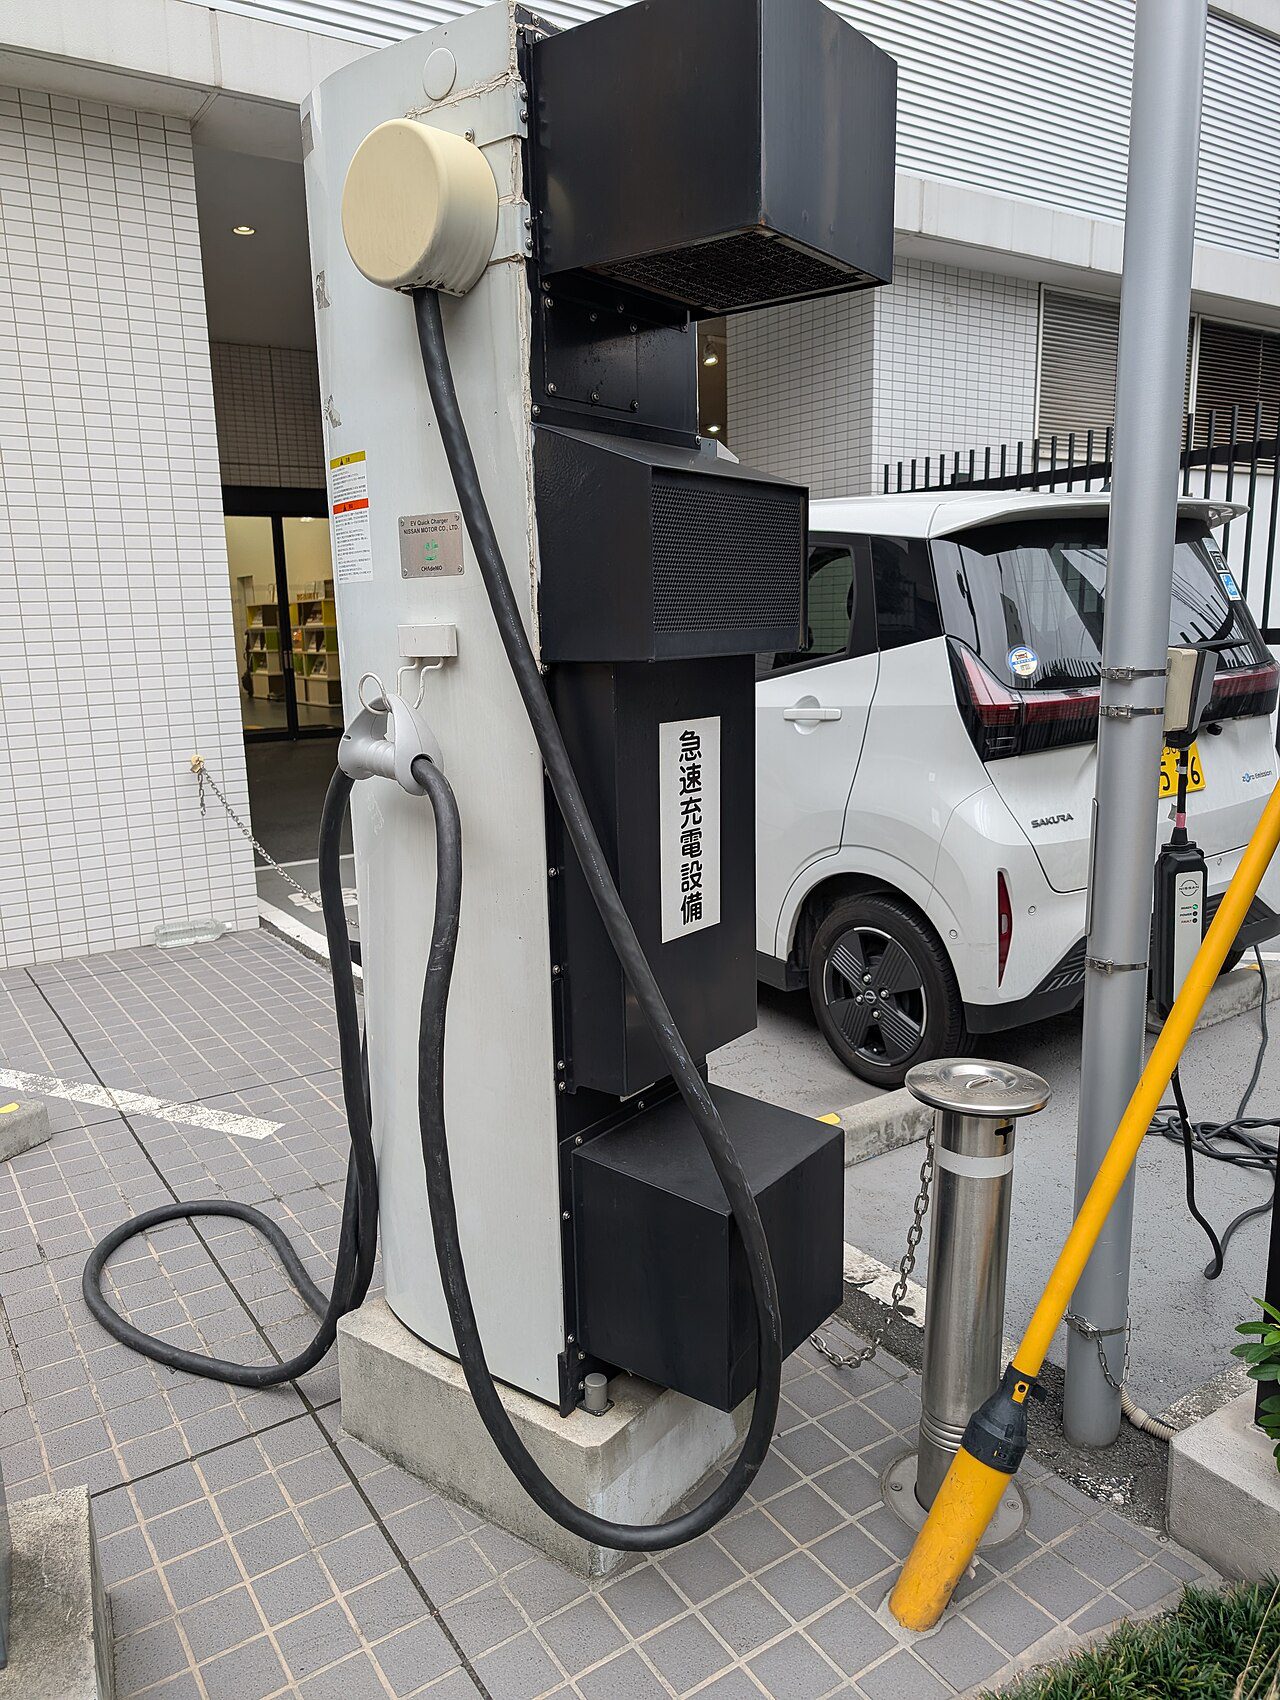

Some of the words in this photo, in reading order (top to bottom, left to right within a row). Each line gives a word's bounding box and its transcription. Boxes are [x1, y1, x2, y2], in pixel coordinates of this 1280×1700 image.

[679, 729, 703, 926] 急速充電設備
[1030, 813, 1074, 829] SAKURA
